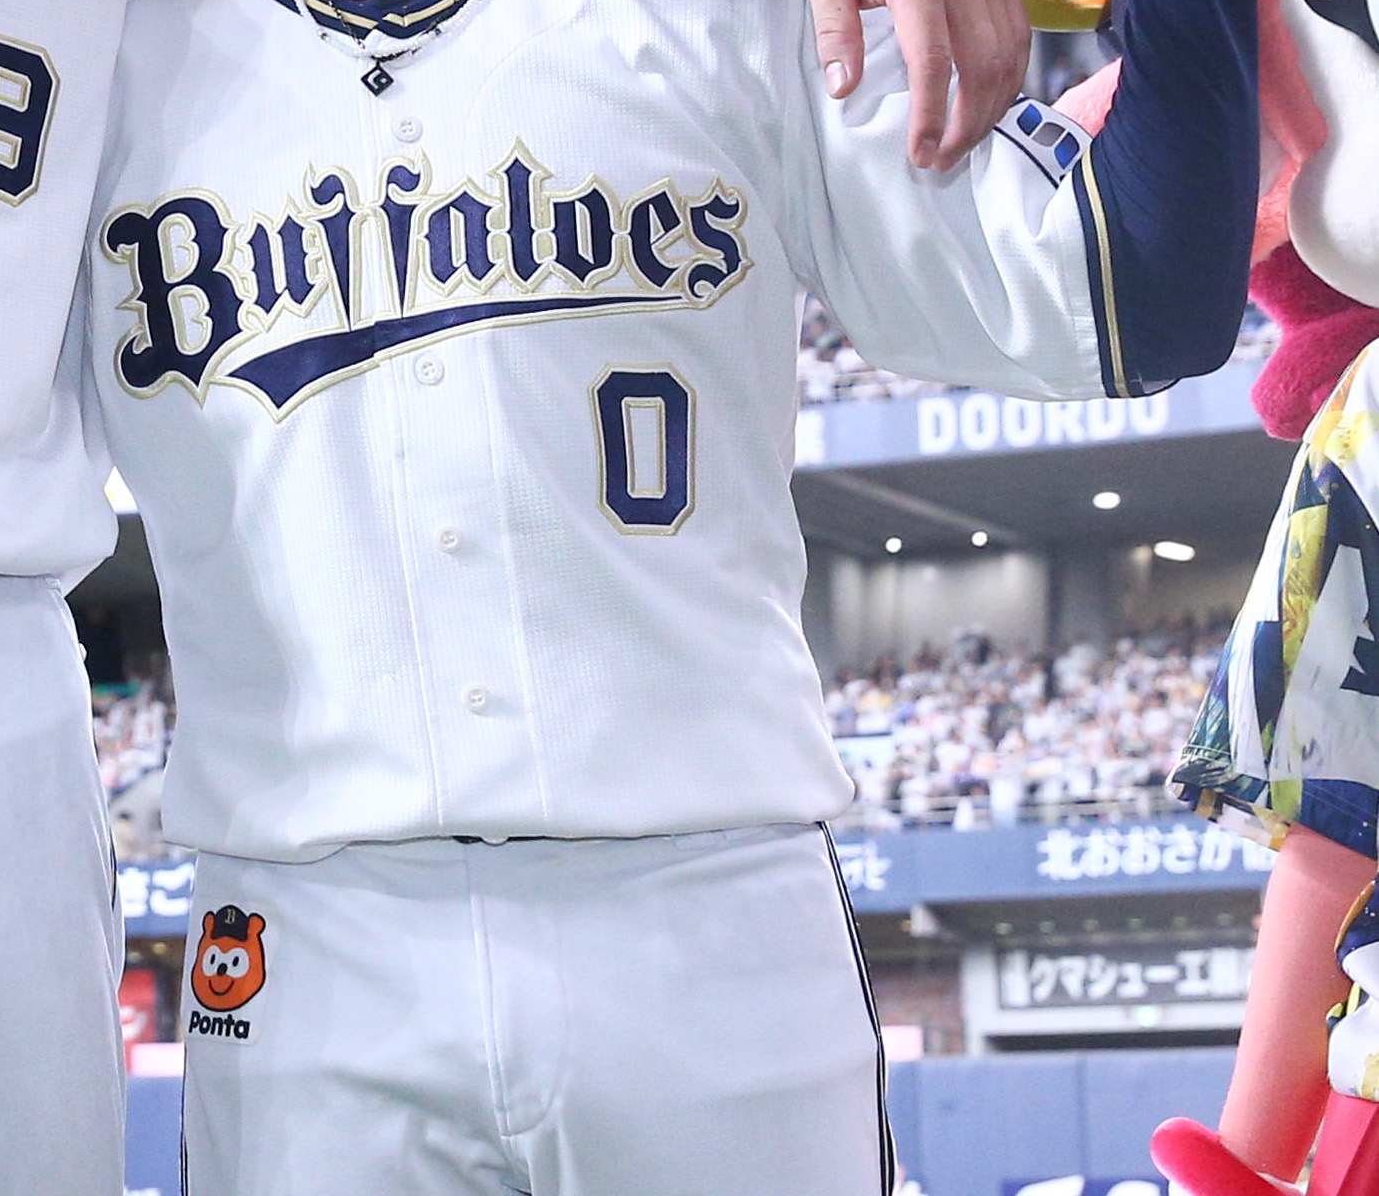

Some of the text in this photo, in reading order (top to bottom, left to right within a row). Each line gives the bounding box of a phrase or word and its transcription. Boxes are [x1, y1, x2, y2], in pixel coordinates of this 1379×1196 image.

[100, 136, 753, 408] Buffaloes
[589, 362, 696, 535] 0
[188, 1010, 251, 1040] Ponta
